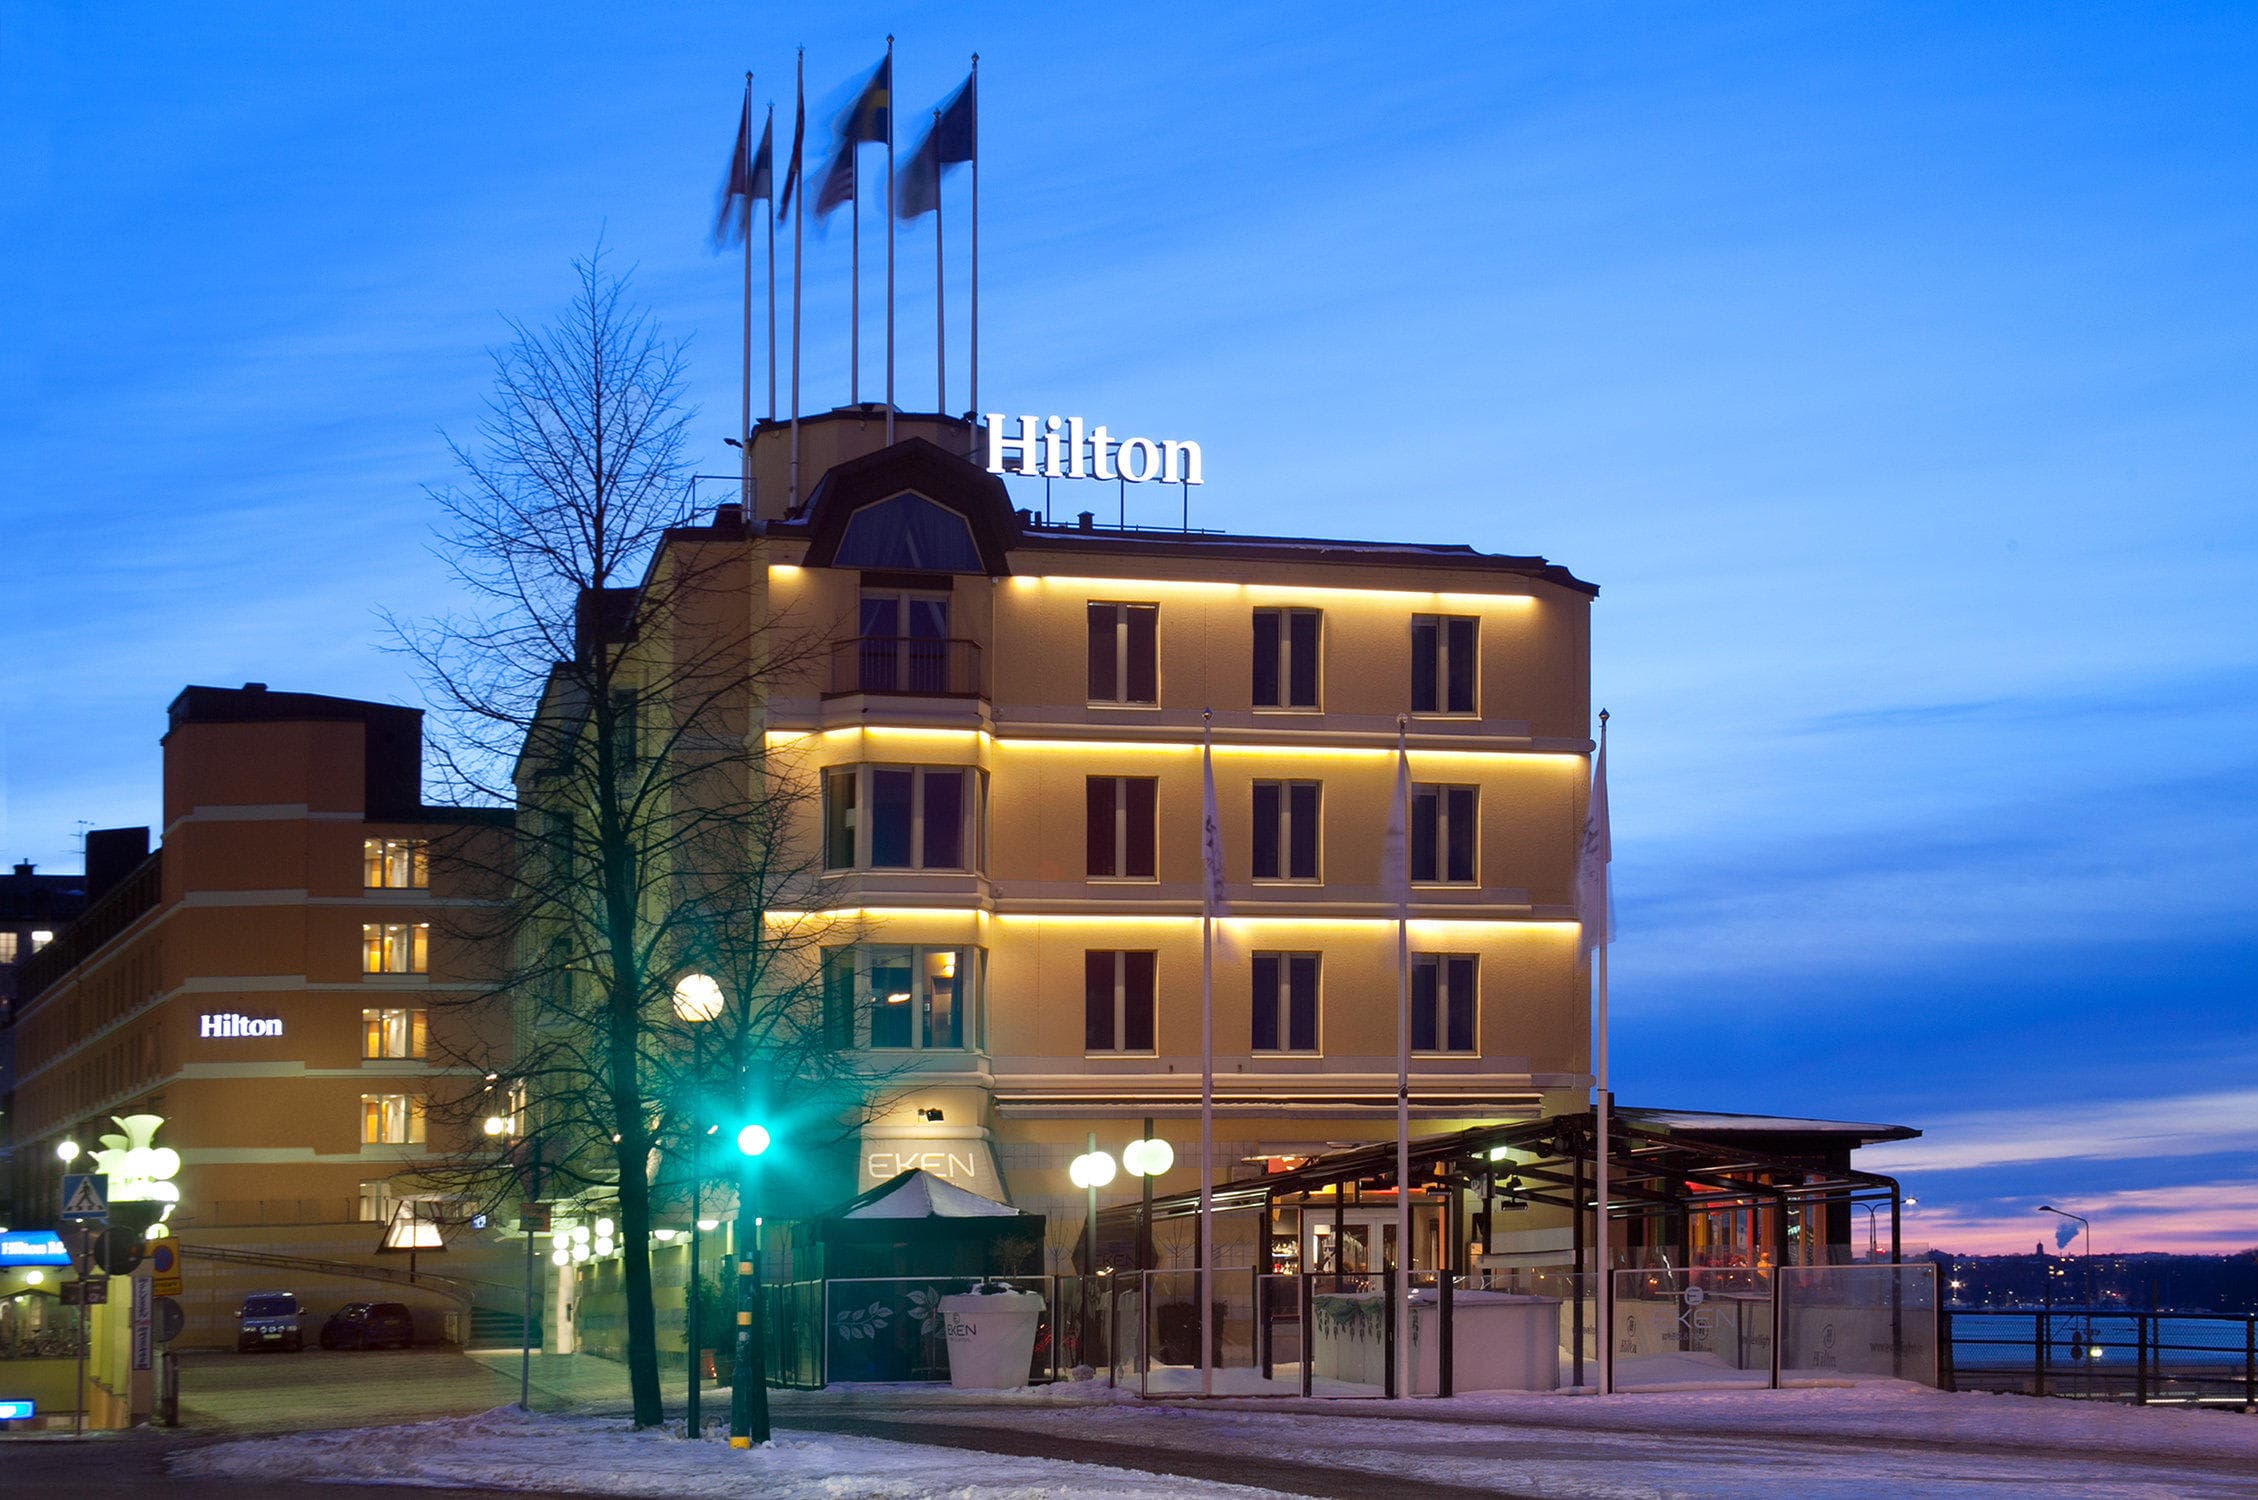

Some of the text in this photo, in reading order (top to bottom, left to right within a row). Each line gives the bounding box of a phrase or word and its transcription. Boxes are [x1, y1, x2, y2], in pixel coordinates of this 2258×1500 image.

[984, 413, 1204, 484] Hilton
[200, 1013, 283, 1037] Hilton
[868, 1152, 976, 1178] EKEN
[947, 1324, 977, 1337] EKEN
[1652, 1308, 1737, 1329] EKEN
